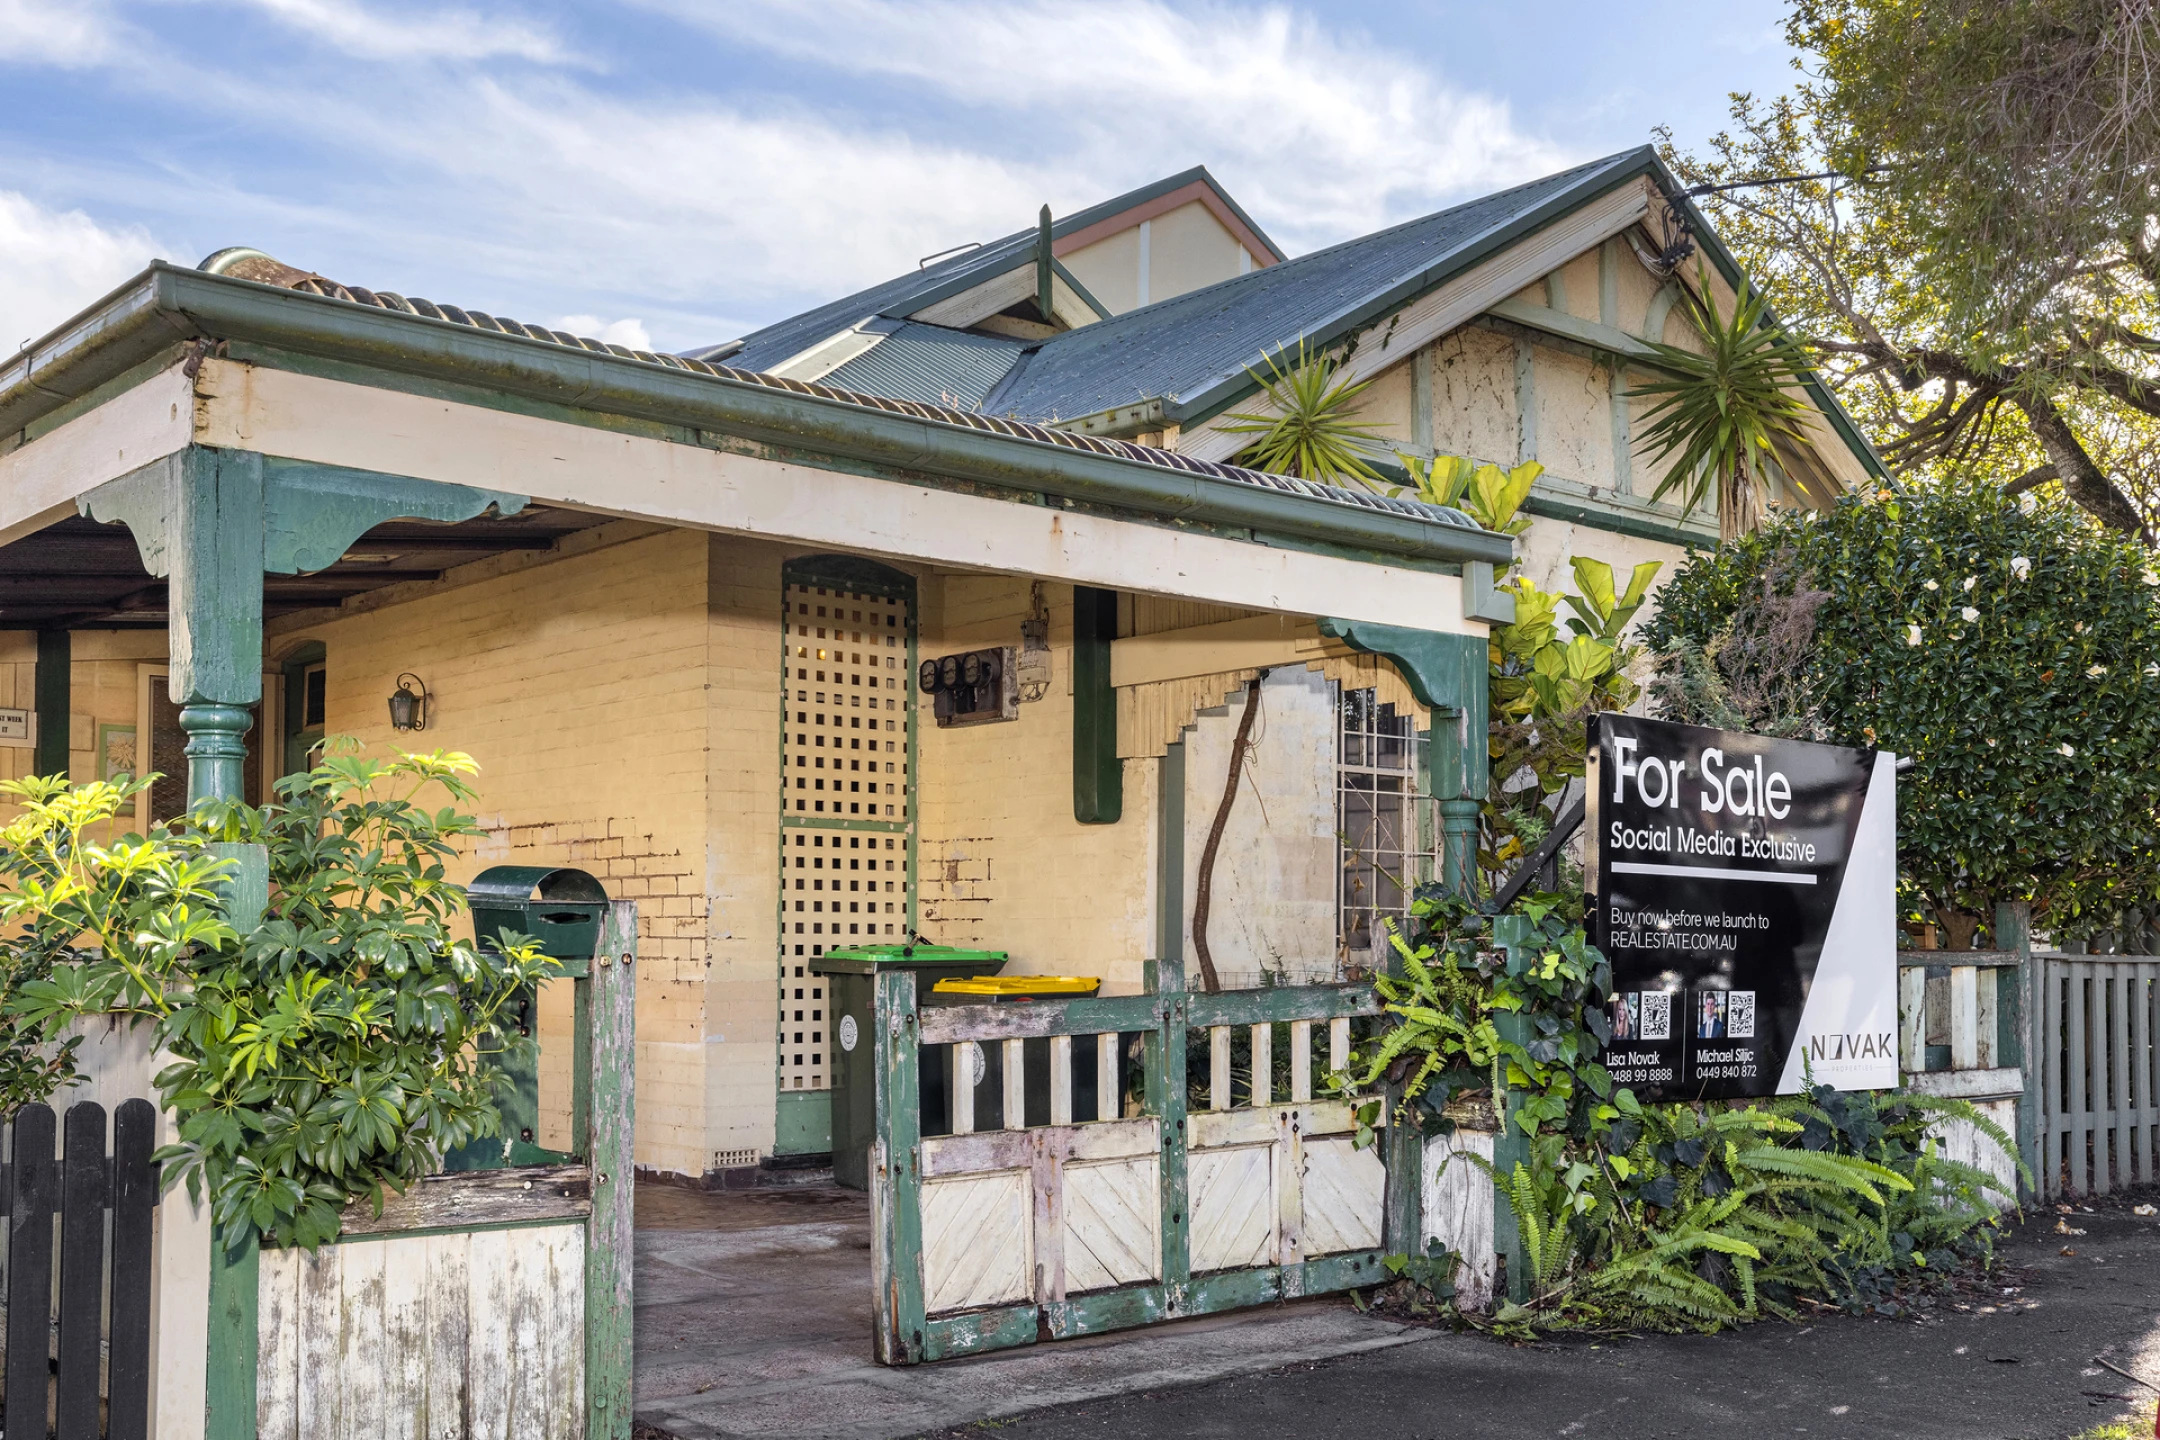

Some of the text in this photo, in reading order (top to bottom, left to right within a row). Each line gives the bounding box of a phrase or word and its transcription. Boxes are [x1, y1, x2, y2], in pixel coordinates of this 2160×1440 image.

[1613, 736, 1792, 820] For Sale
[1611, 821, 1816, 862] Social Media Exclusive
[1611, 907, 1770, 929] Buy now before we launch to
[1611, 931, 1737, 950] REALESTATE.COM.AU
[1606, 1050, 1660, 1066] Lisa Novak
[1696, 1048, 1734, 1063] Michael
[1634, 1069, 1647, 1081] 99
[1649, 1068, 1673, 1081] 8888
[1696, 1064, 1757, 1079] 0449 840 872
